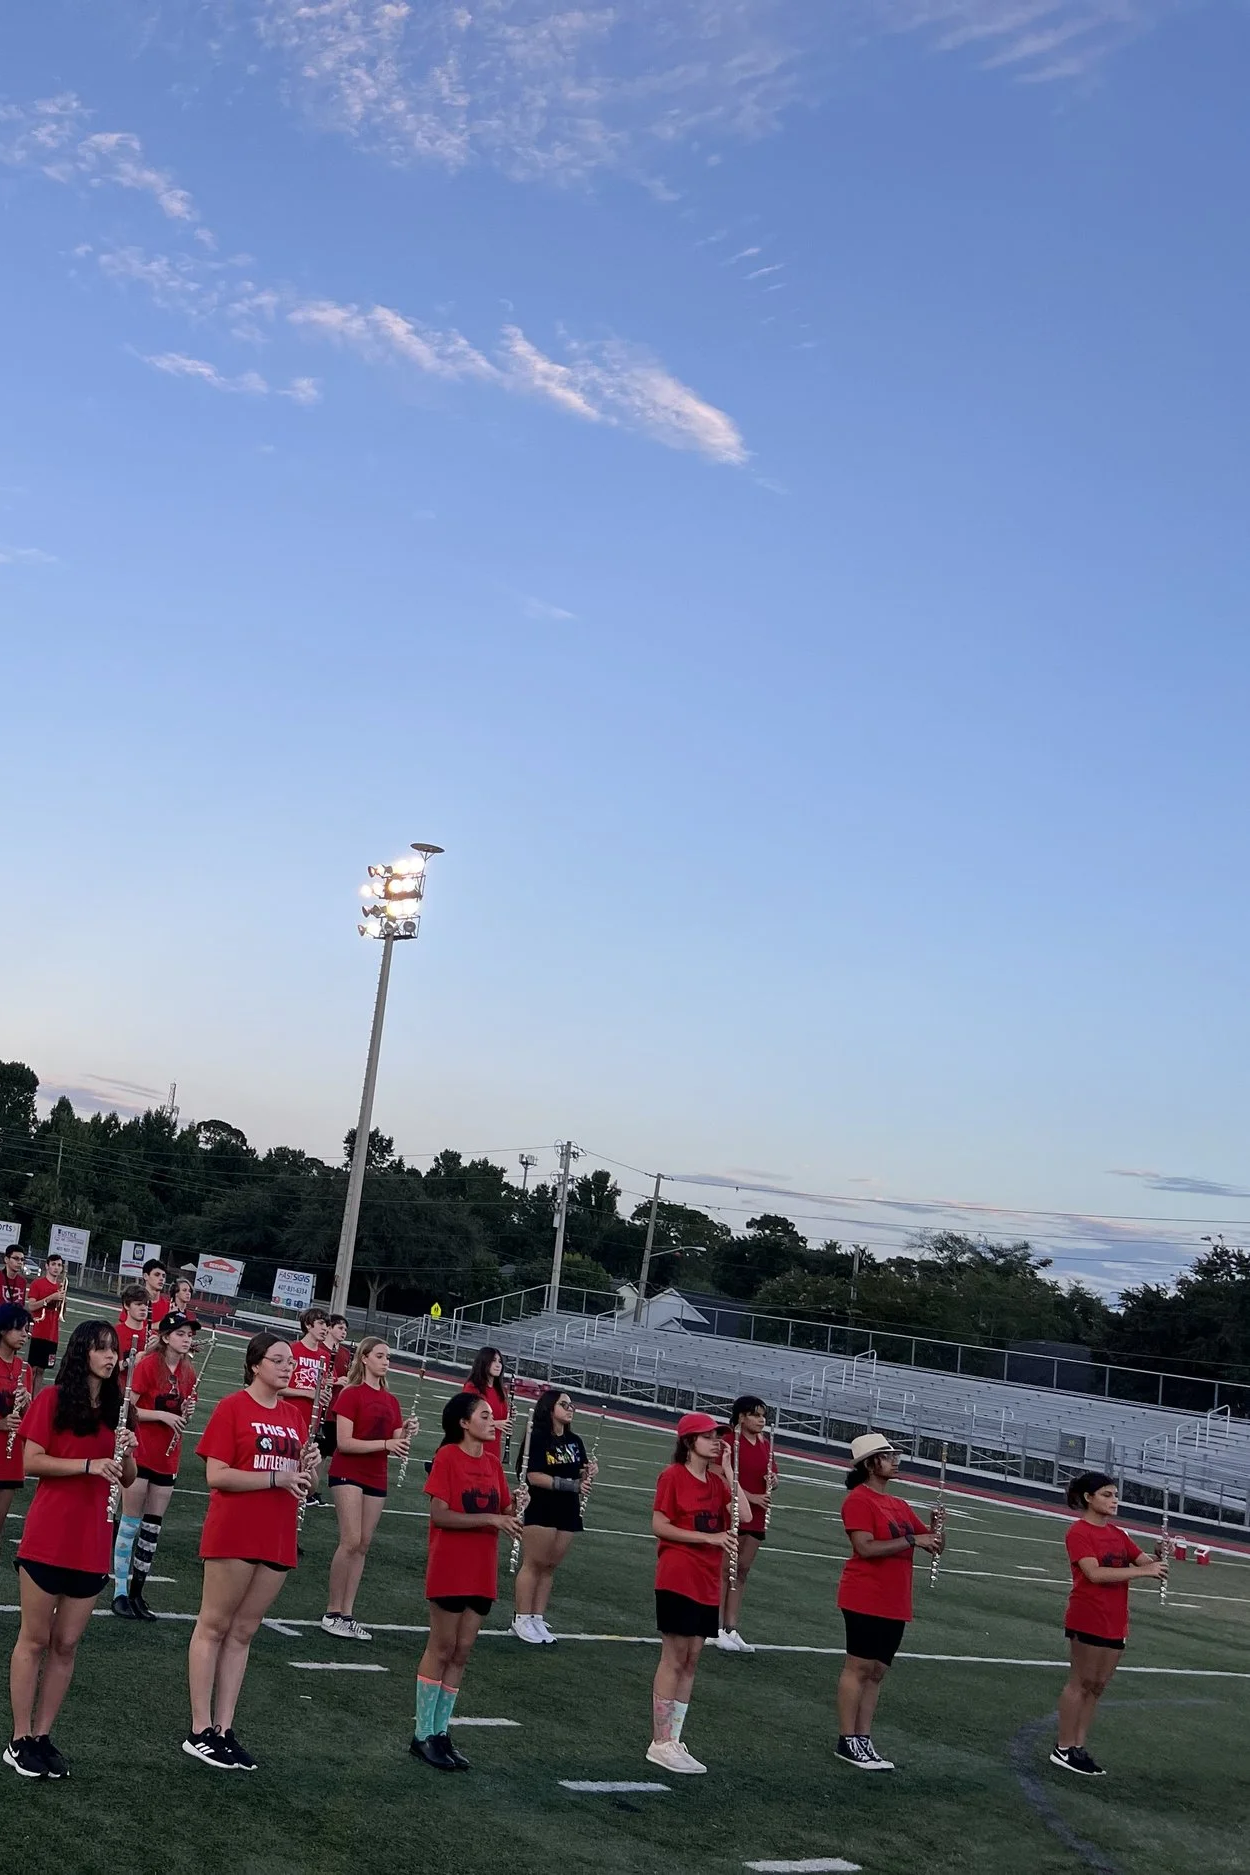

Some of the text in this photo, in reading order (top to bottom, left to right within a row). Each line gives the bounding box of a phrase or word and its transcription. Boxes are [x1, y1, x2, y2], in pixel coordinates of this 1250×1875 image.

[299, 1356, 327, 1371] FUTU
[251, 1422, 299, 1440] THIS IS
